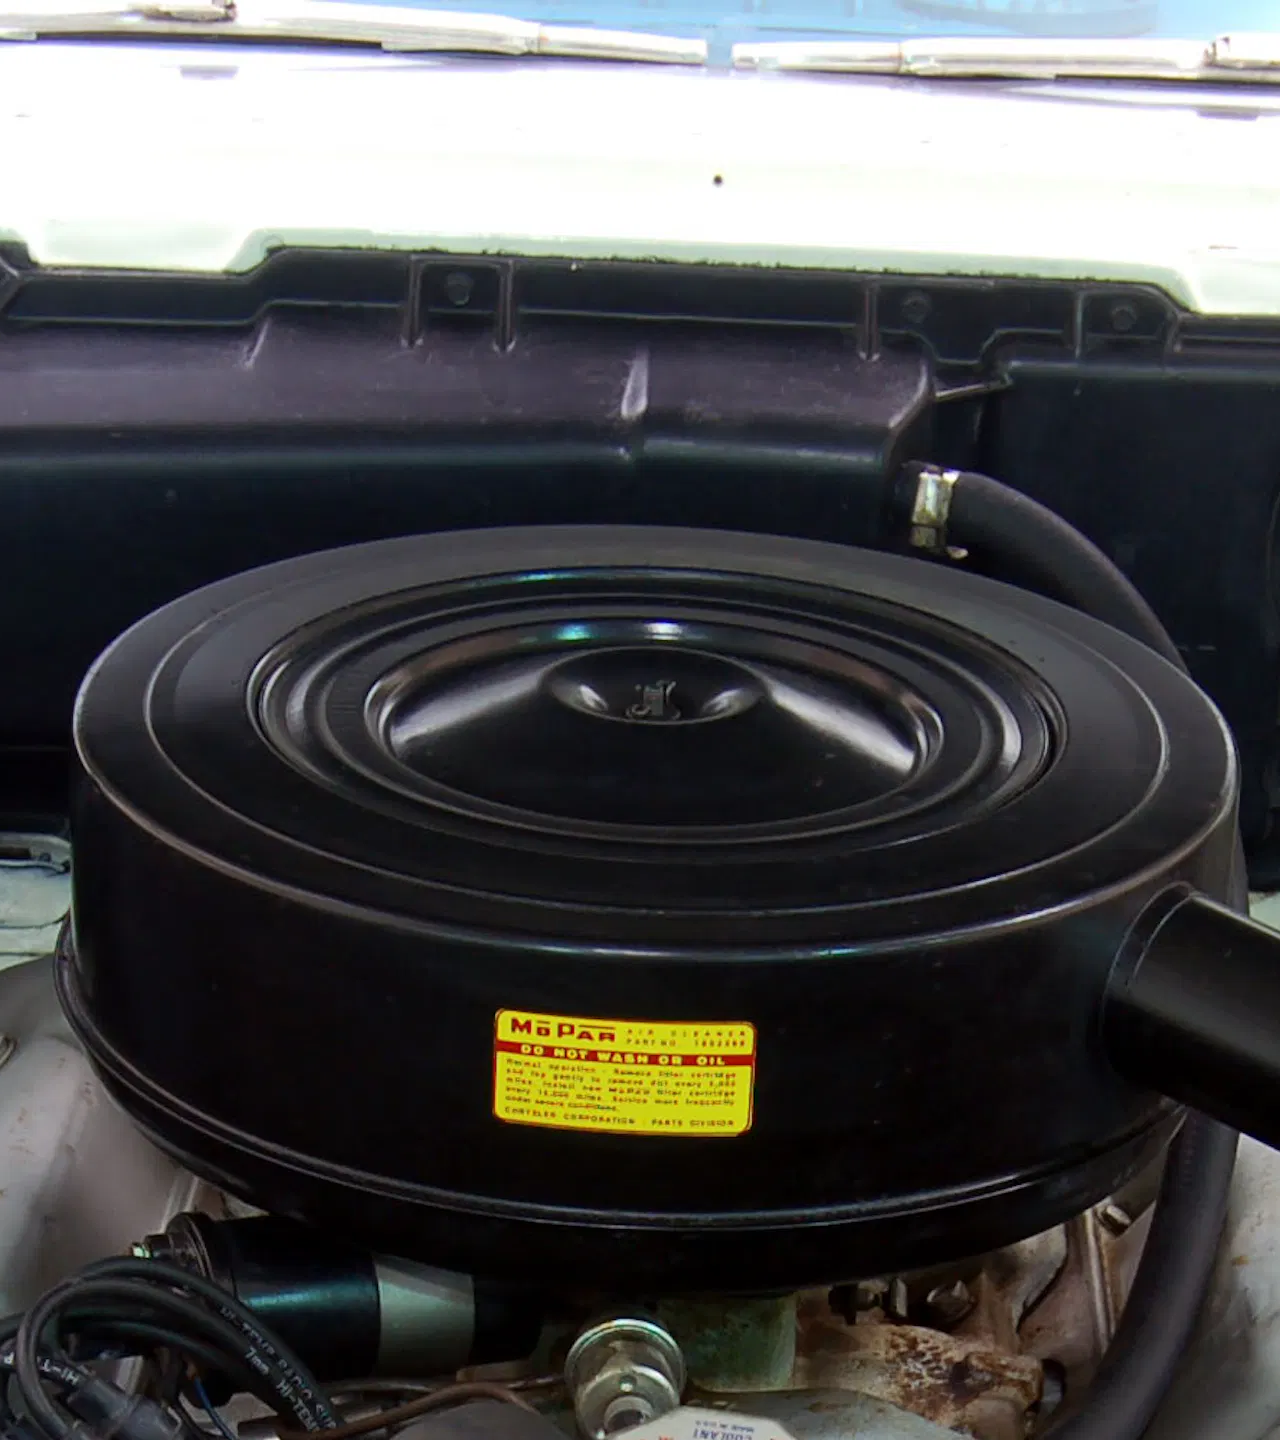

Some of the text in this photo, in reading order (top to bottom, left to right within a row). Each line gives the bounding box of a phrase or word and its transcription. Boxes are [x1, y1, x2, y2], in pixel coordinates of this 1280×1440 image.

[521, 1043, 726, 1066] DO NOT WASH OR OIL
